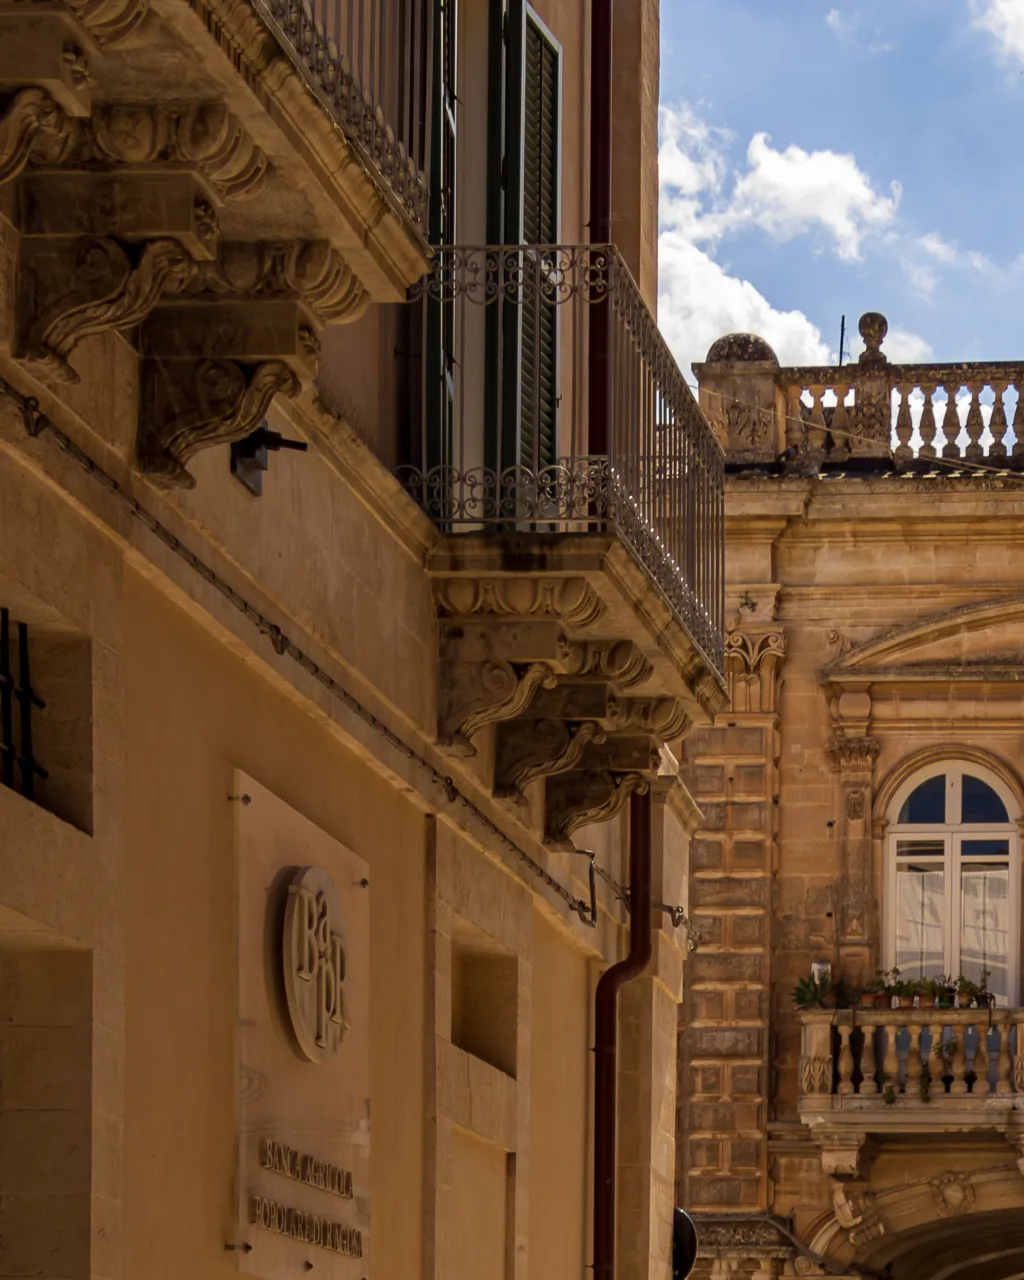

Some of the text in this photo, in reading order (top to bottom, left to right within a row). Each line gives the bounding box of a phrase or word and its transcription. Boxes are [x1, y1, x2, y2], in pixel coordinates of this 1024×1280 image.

[261, 1137, 354, 1199] BANCA AGRICOLA
[250, 1196, 363, 1259] POPOLARE DI RAGUSA
